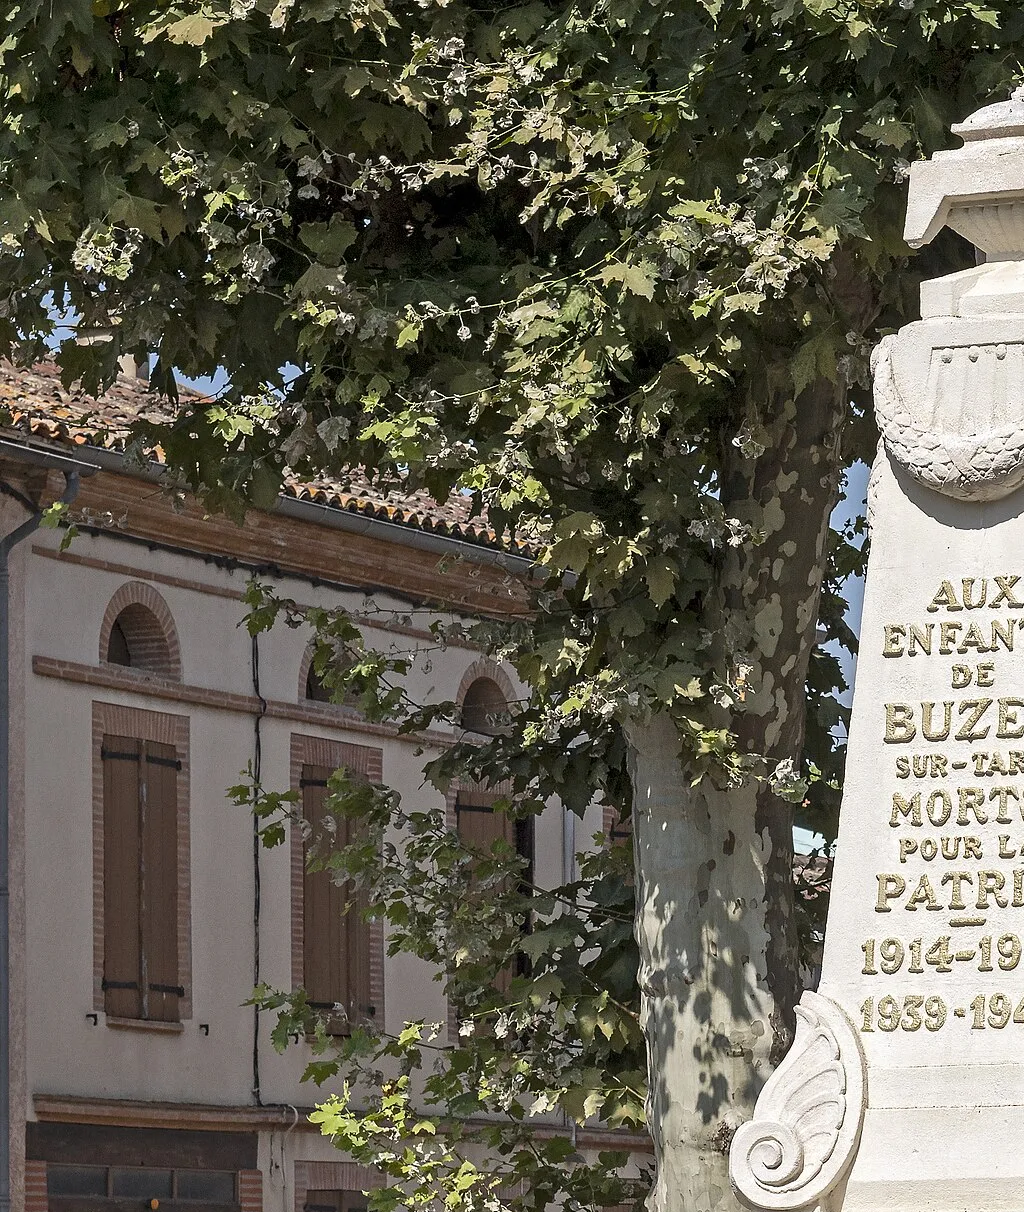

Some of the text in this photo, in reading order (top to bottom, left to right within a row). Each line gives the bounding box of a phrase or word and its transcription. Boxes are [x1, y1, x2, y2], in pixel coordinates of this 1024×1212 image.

[927, 575, 1024, 612] AUX
[951, 662, 995, 689] DE
[899, 835, 983, 863] POUR
